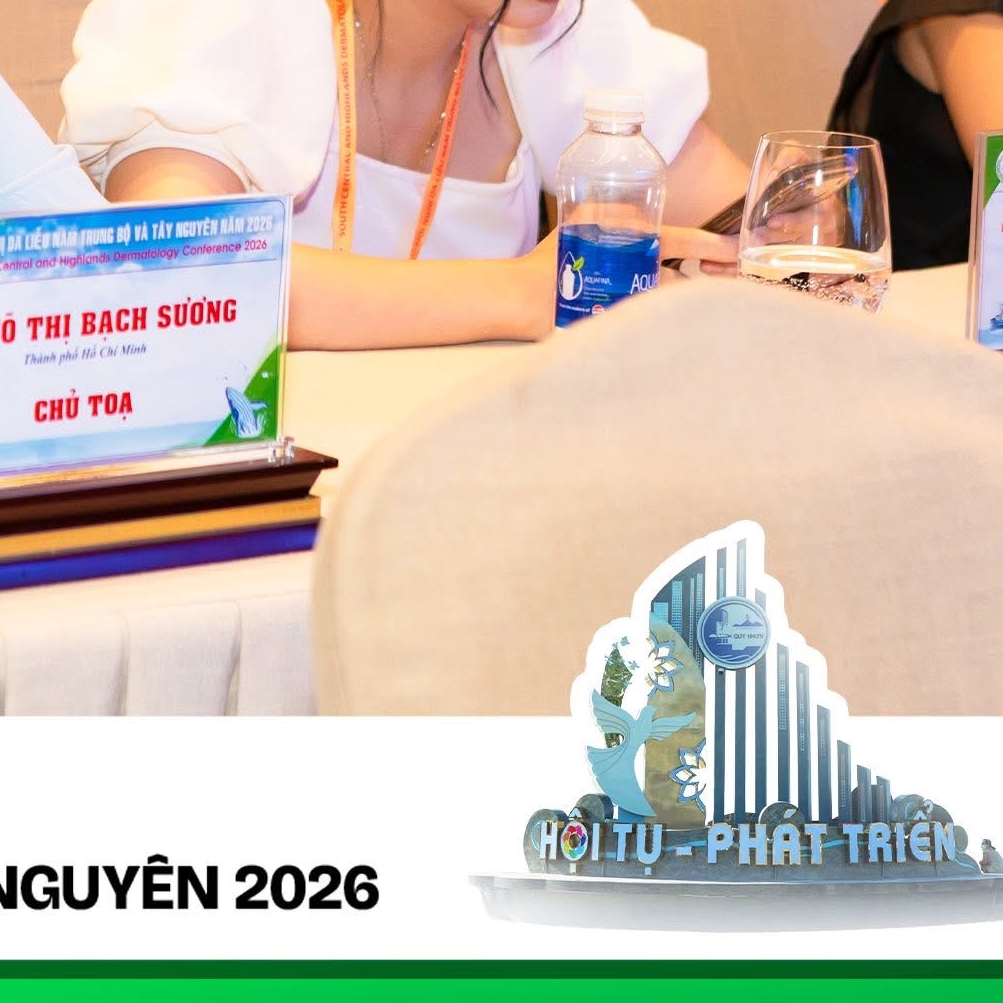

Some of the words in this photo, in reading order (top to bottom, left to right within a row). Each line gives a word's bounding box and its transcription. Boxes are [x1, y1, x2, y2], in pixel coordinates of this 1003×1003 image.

[340, 152, 351, 199] CENTRAL
[81, 227, 114, 245] TRUNG
[117, 223, 131, 246] BỘ
[135, 222, 148, 242] VÀ
[152, 220, 172, 240] TÂY
[176, 217, 218, 239] NGUYÊN
[221, 215, 244, 235] NĂM
[338, 201, 349, 237] SOUTH
[36, 258, 57, 269] and
[60, 253, 110, 270] Highlands
[113, 247, 179, 262] Dermatology
[183, 242, 242, 256] Conference
[245, 239, 267, 251] 2026
[27, 314, 71, 345] THỊ
[81, 307, 147, 341] BẠCH
[157, 296, 237, 329] SƯƠNG
[25, 352, 56, 365] Thành
[58, 347, 77, 366] phố
[100, 346, 117, 358] Chí
[121, 344, 147, 356] Minh
[34, 388, 79, 423] CHỦ
[87, 392, 132, 421] TOẠ
